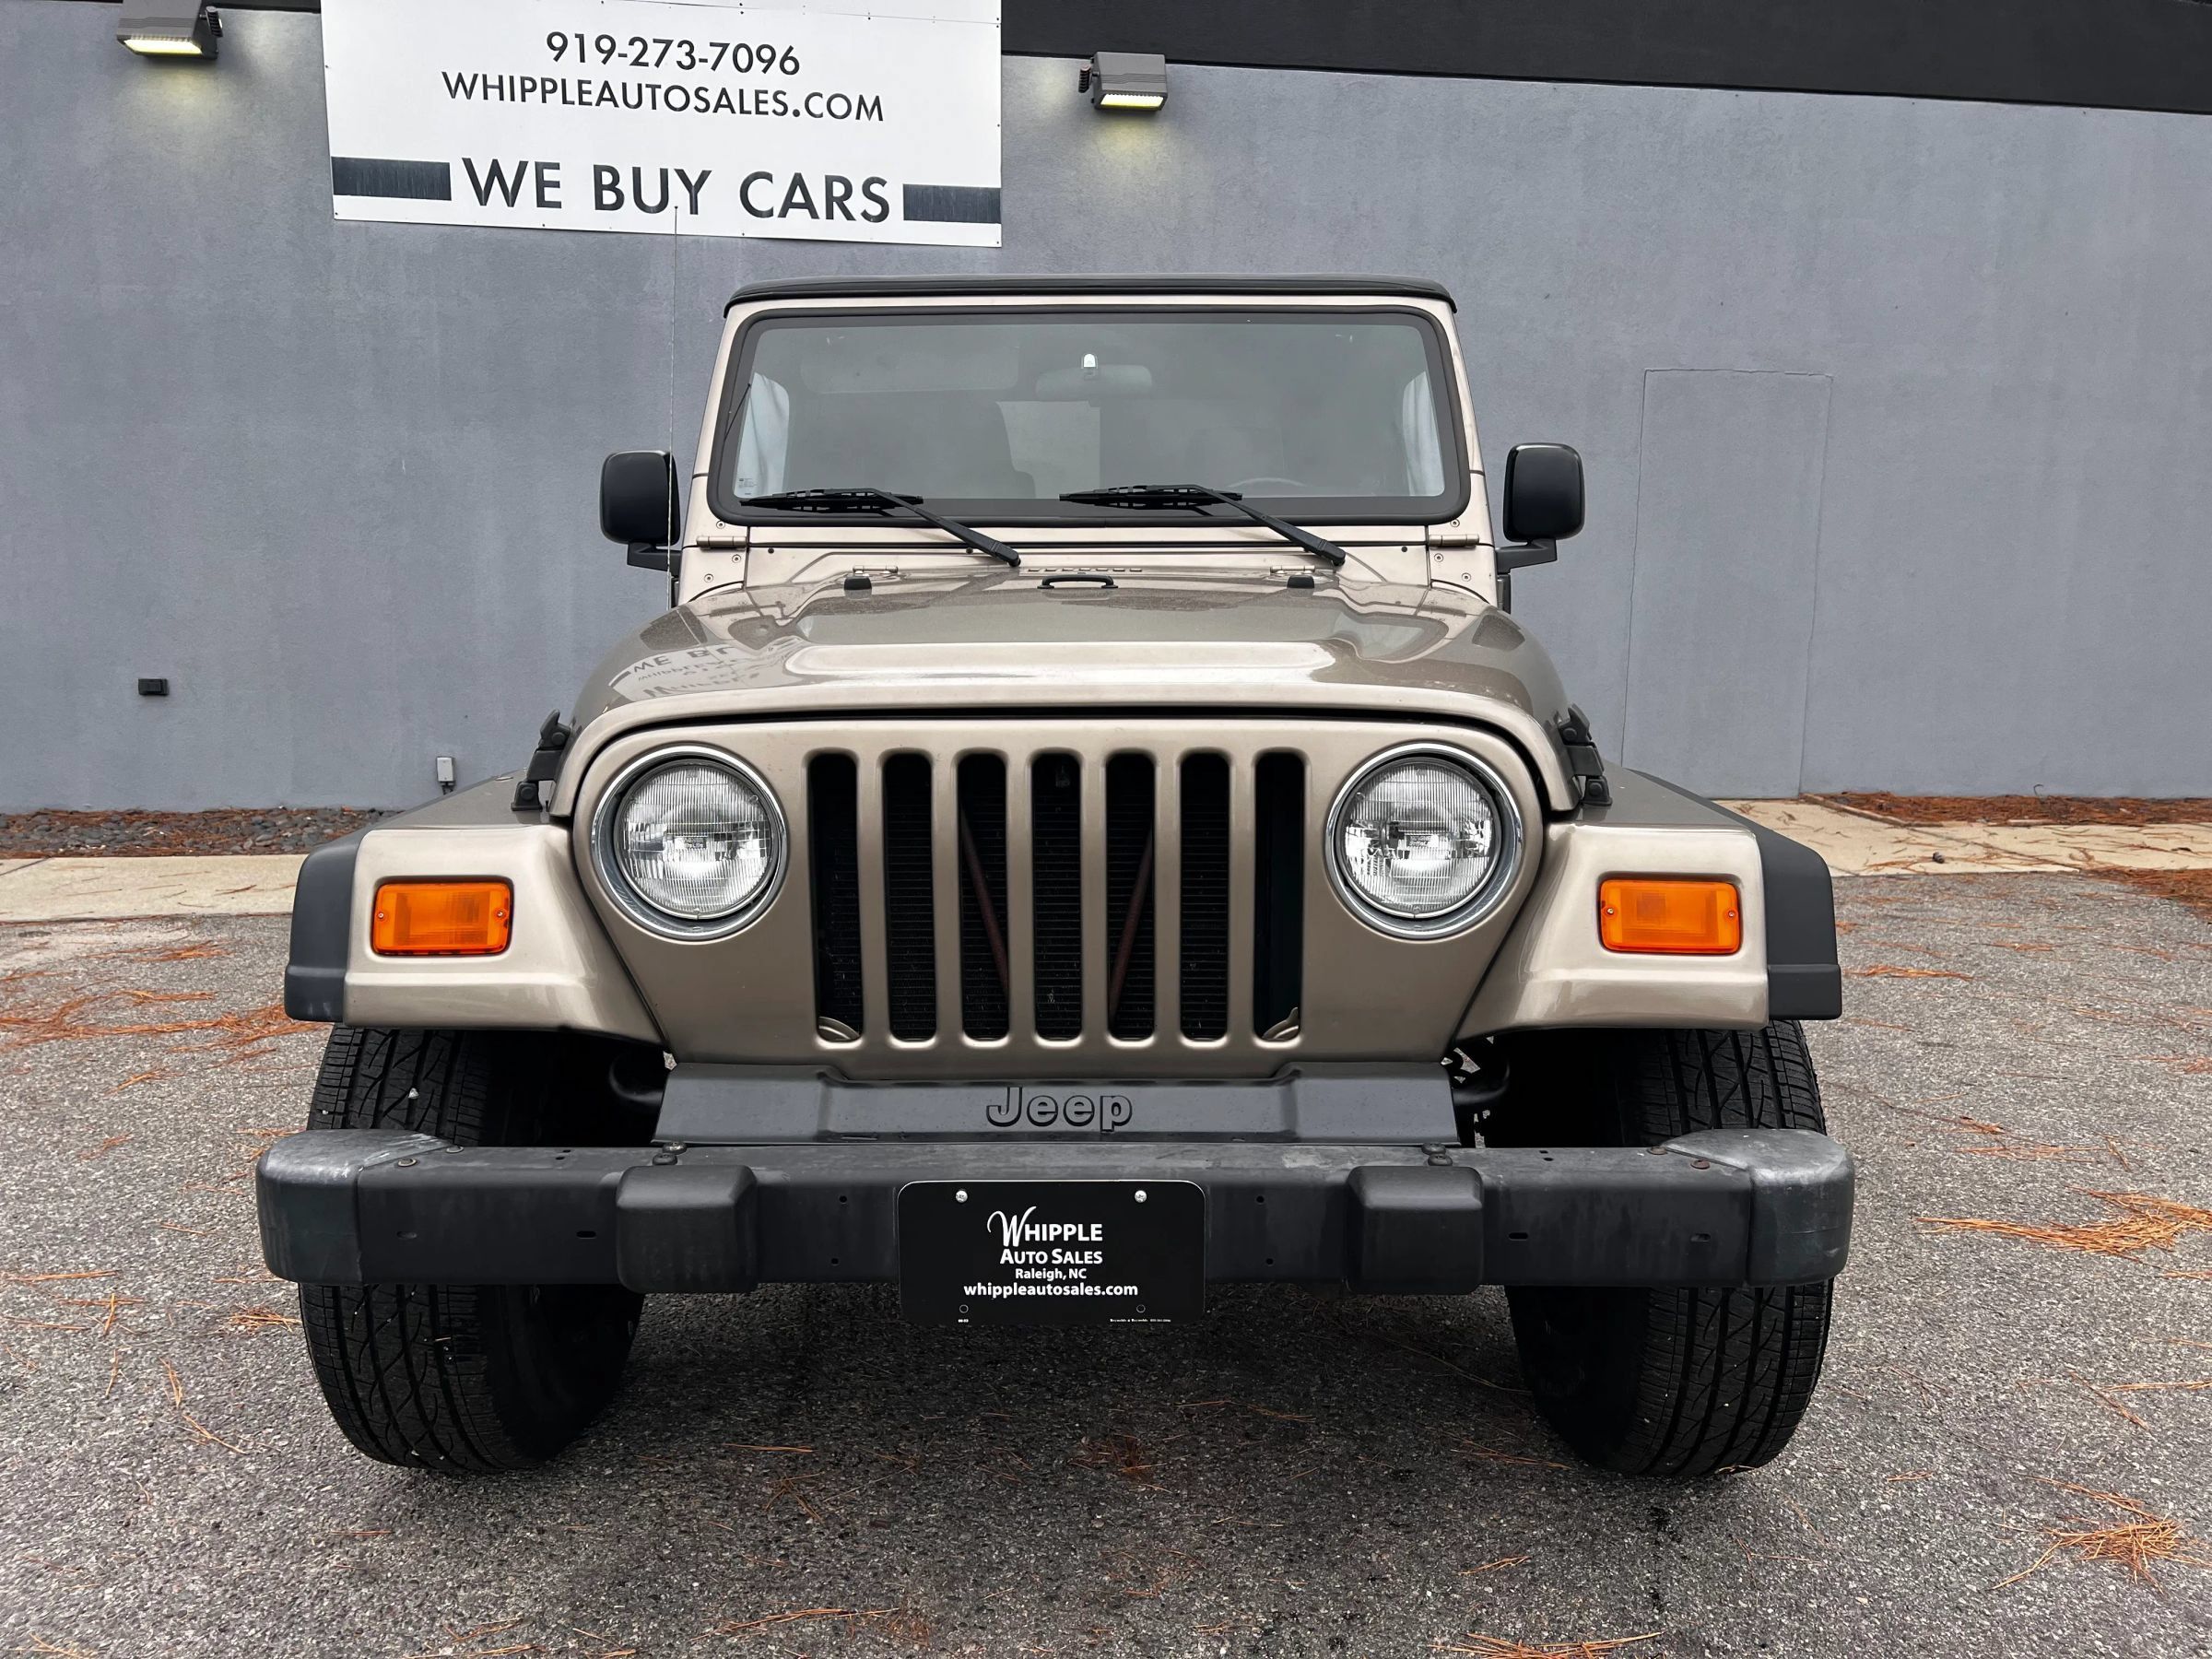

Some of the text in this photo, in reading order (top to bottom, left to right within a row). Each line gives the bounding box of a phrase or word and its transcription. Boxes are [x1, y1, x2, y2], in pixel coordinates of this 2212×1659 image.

[546, 31, 800, 76] 919-273-7096
[441, 71, 884, 122] WHIPPLEAUTOSALES.COM
[461, 157, 890, 224] WE BUY CARS
[986, 1086, 1133, 1135] Jeep
[986, 1206, 1103, 1247] WHIPPLE
[999, 1248, 1103, 1265] AUTO SALES
[1015, 1267, 1088, 1282] Raleigh, NC
[963, 1281, 1138, 1299] whippleautosales.com
